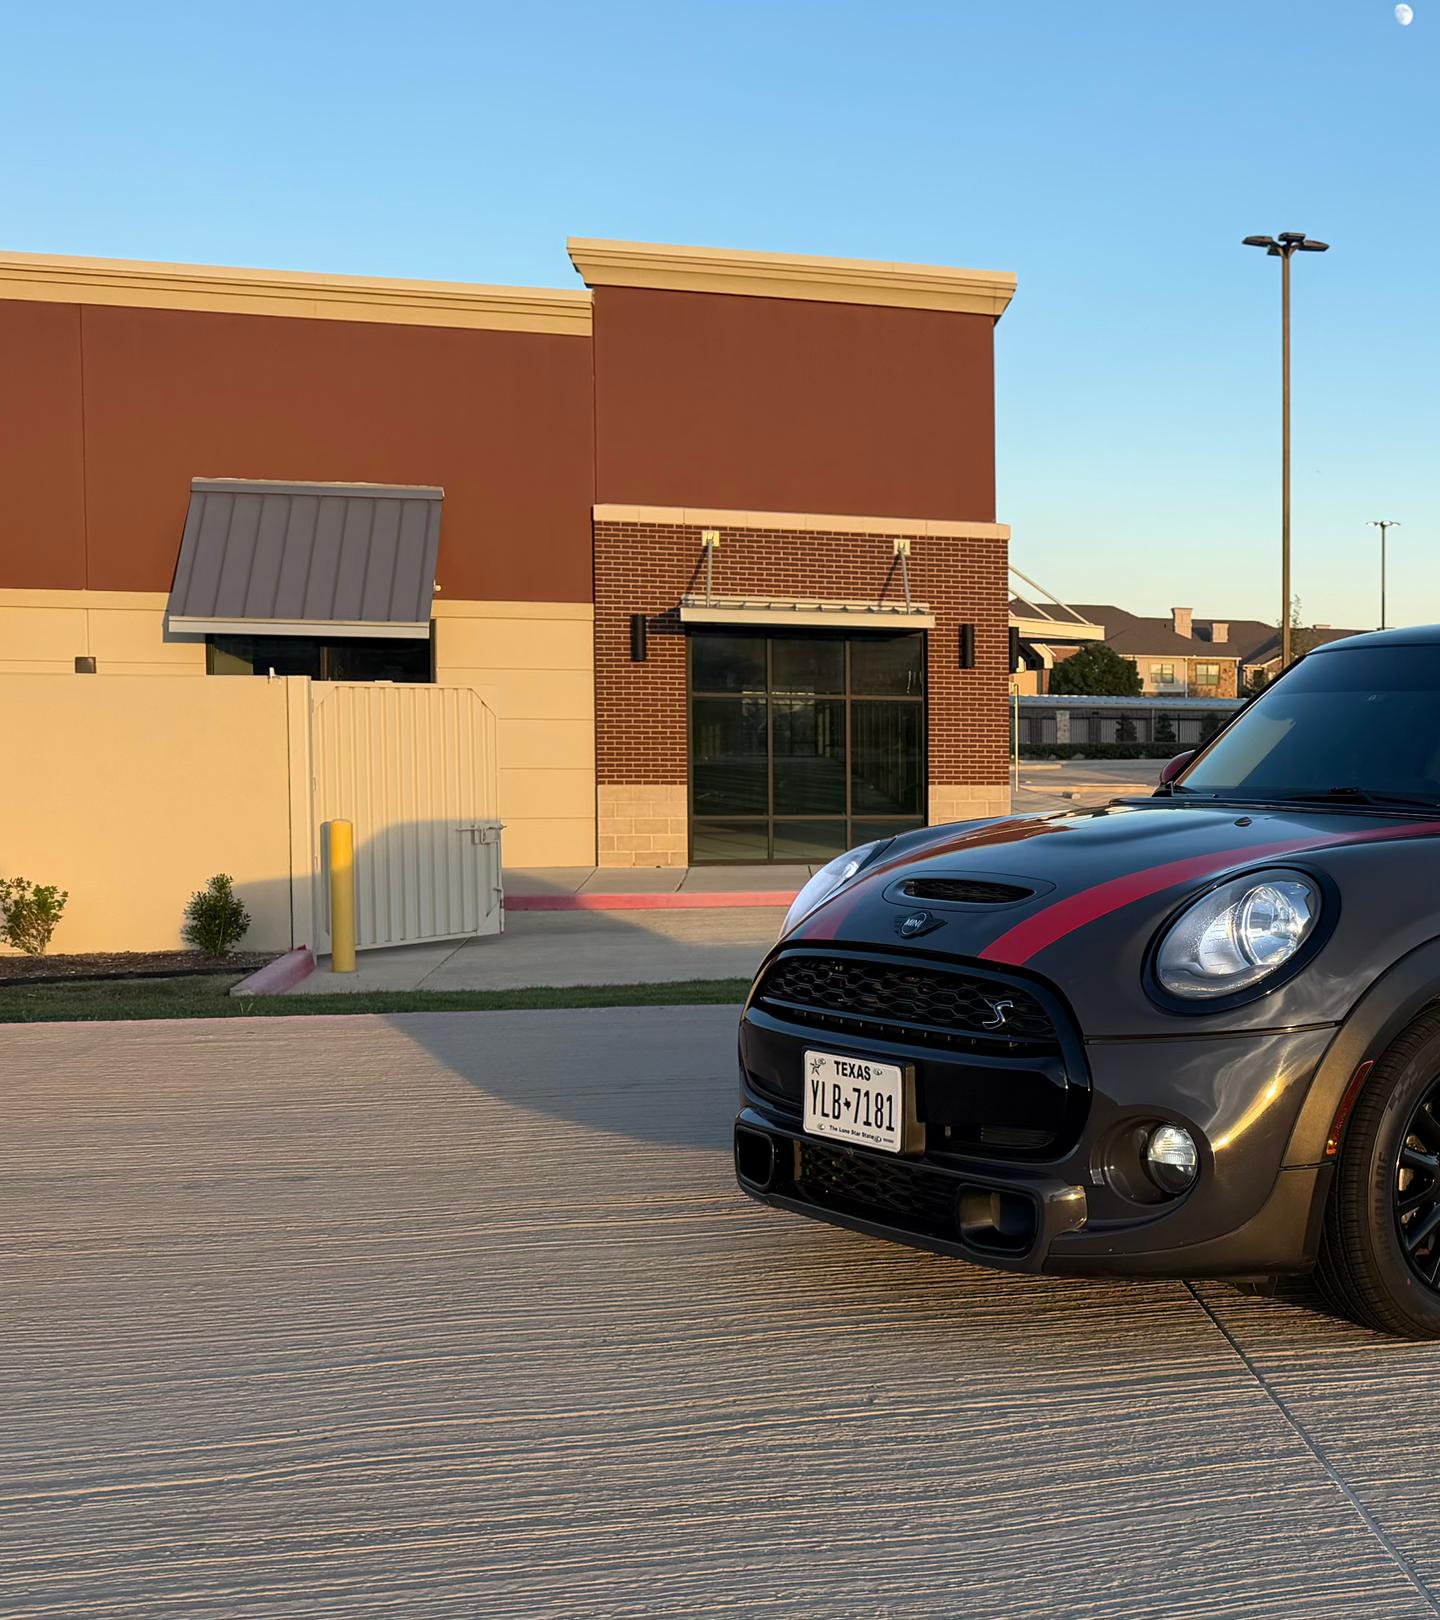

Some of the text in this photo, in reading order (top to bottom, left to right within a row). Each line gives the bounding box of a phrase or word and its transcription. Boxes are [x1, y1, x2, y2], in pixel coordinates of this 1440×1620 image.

[905, 918, 922, 928] MINI
[834, 1060, 871, 1081] TEXAS
[838, 1126, 850, 1135] Lone
[851, 1129, 861, 1137] Star
[861, 1131, 875, 1140] State
